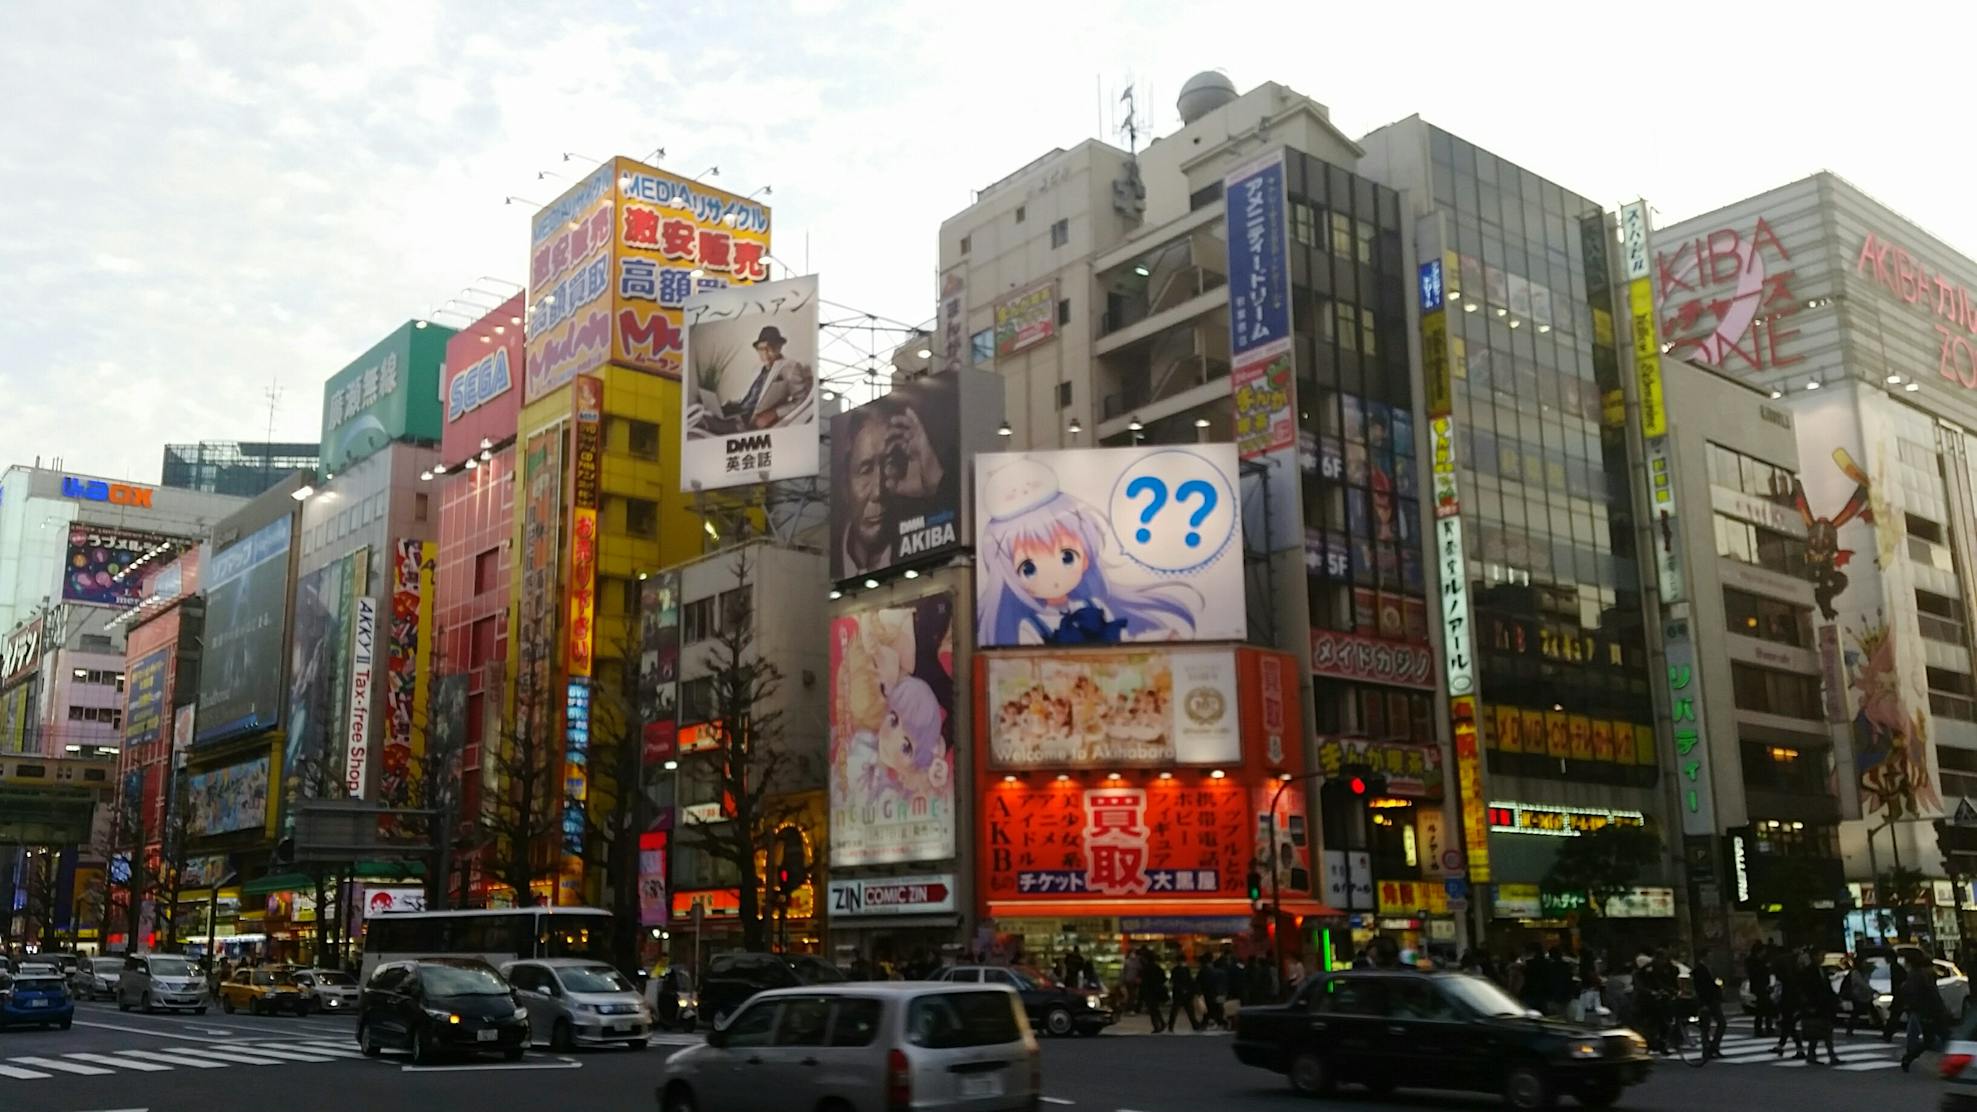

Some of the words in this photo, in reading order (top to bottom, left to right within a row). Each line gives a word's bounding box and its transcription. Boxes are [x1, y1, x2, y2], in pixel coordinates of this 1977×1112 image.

[622, 172, 768, 232] MEDIAリサイクル
[623, 206, 765, 279] 激安販売
[621, 261, 727, 305] 高額
[448, 346, 512, 421] SEGA
[726, 434, 771, 454] DMM
[726, 454, 772, 472] 英会話
[1322, 457, 1342, 478] 6F
[898, 523, 956, 557] AKIBA
[899, 515, 925, 534] DMM
[1327, 555, 1348, 576] 5F
[358, 600, 373, 654] AKKY
[1317, 637, 1431, 682] メイドカジノ
[998, 749, 1066, 762] Welcome
[1072, 749, 1088, 760] to
[1092, 747, 1175, 760] Akihabara
[1669, 665, 1700, 813] リバティー
[349, 746, 365, 791] Shop
[1018, 793, 1036, 866] アイドル
[1039, 793, 1058, 845] アニメ
[1152, 793, 1172, 866] フィギュア
[1175, 793, 1193, 845] ホビー
[1197, 792, 1217, 865] 携帯電話
[1089, 795, 1146, 889] 買取
[832, 883, 861, 912] ZIN
[866, 886, 906, 904] COMIC
[909, 886, 927, 902] ZIN
[1020, 872, 1084, 892] チケット
[1154, 871, 1217, 891] 大黒屋
